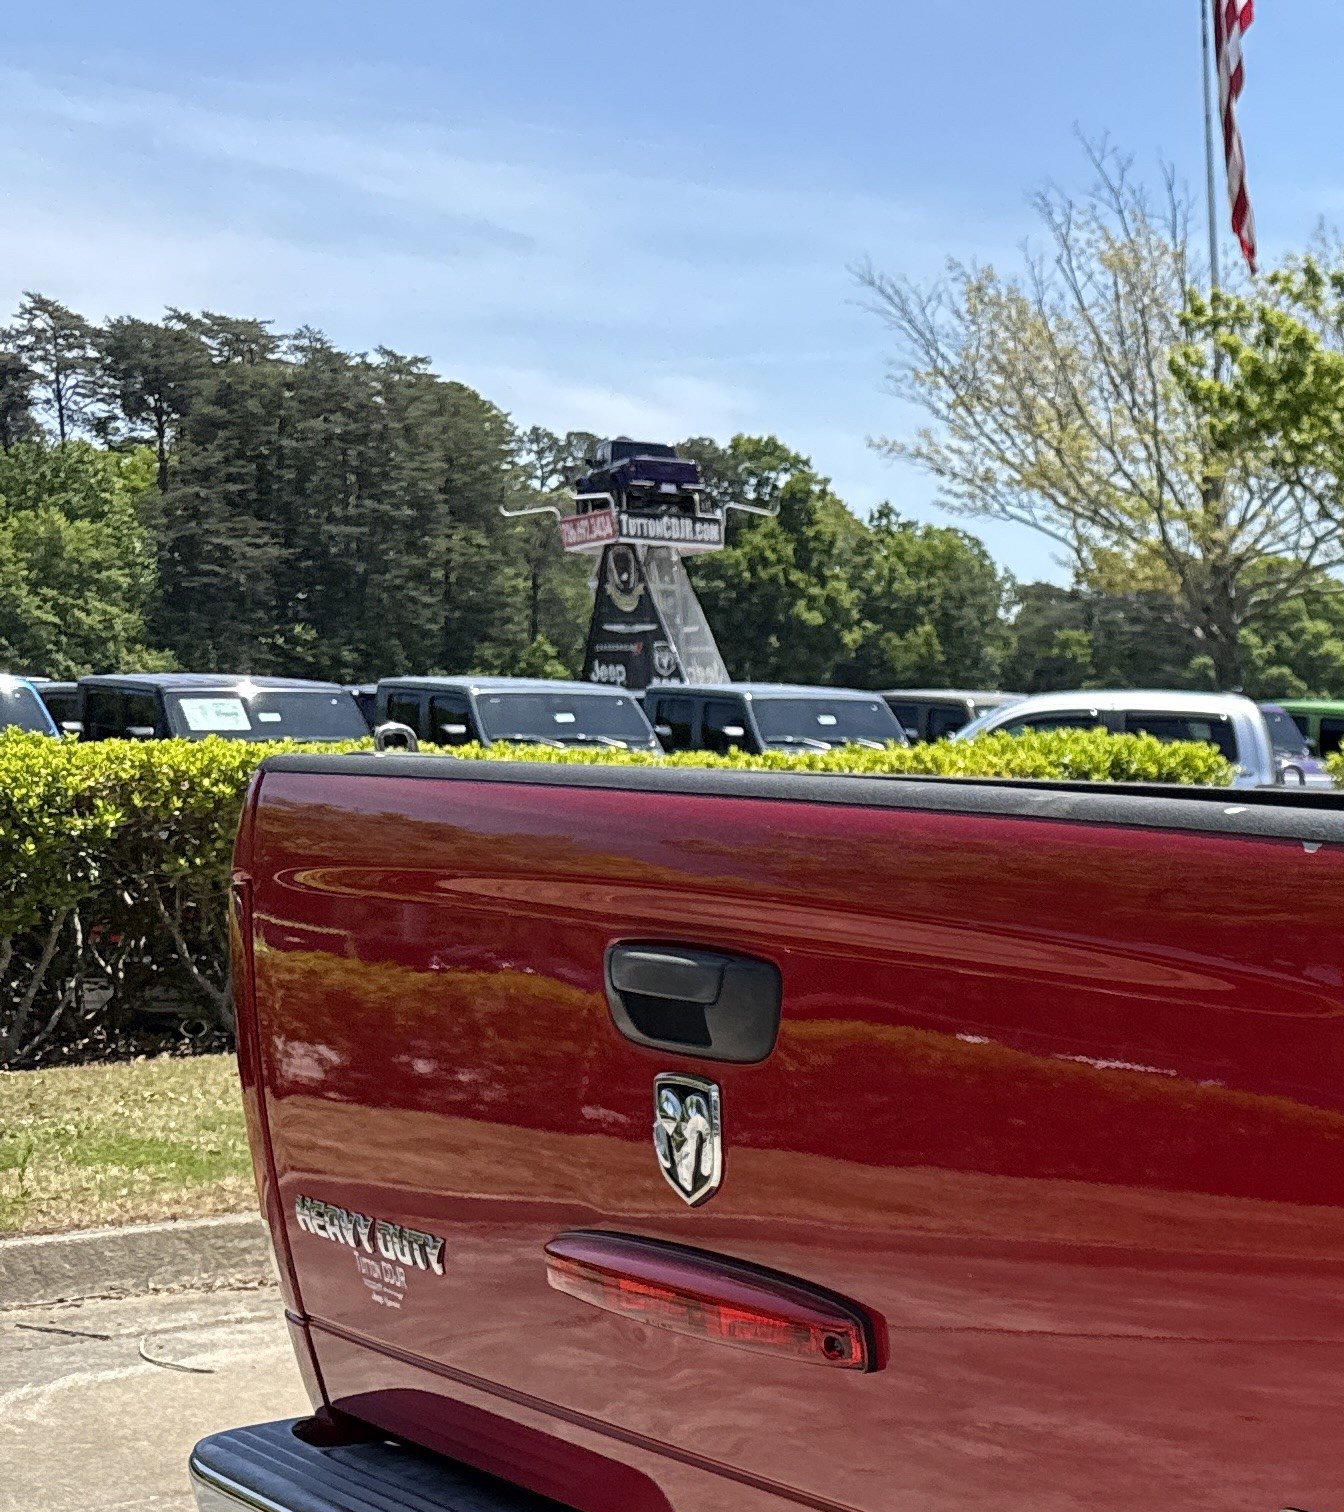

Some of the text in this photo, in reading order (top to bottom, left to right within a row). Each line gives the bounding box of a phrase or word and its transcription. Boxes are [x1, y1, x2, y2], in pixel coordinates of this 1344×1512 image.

[590, 659, 627, 686] Jeep
[295, 1194, 446, 1276] HEAVY DUTY
